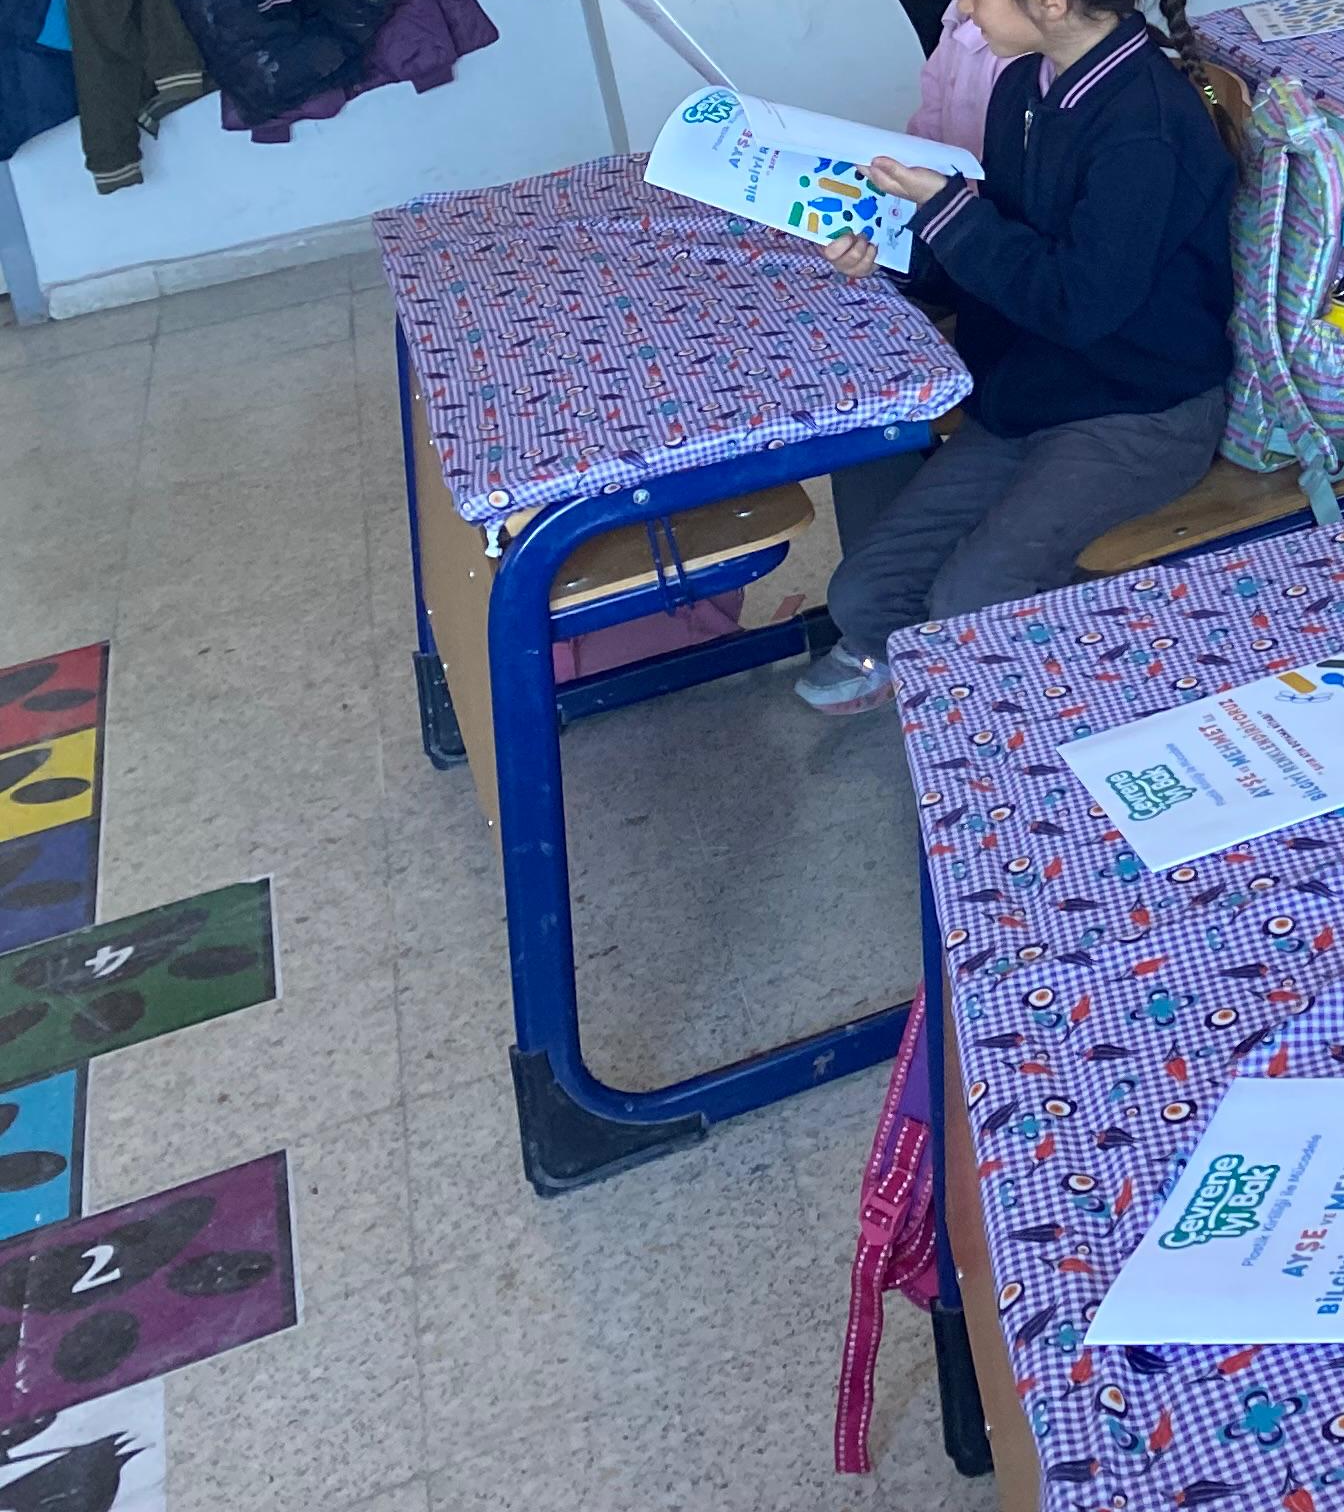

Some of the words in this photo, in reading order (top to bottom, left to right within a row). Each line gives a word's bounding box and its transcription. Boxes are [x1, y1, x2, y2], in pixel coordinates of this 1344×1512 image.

[1198, 724, 1251, 768] MEHMET
[1218, 698, 1299, 774] RENKLENDİRİYORUZ
[1109, 771, 1162, 820] Çevrene
[1140, 766, 1176, 790] Bak
[1236, 772, 1275, 798] AYŞE
[1283, 770, 1328, 802] BİLGİYİ
[1163, 1156, 1240, 1247] Çevrene
[1228, 1168, 1275, 1207] Bak
[71, 1245, 121, 1294] 2
[1282, 1228, 1328, 1277] AYŞE
